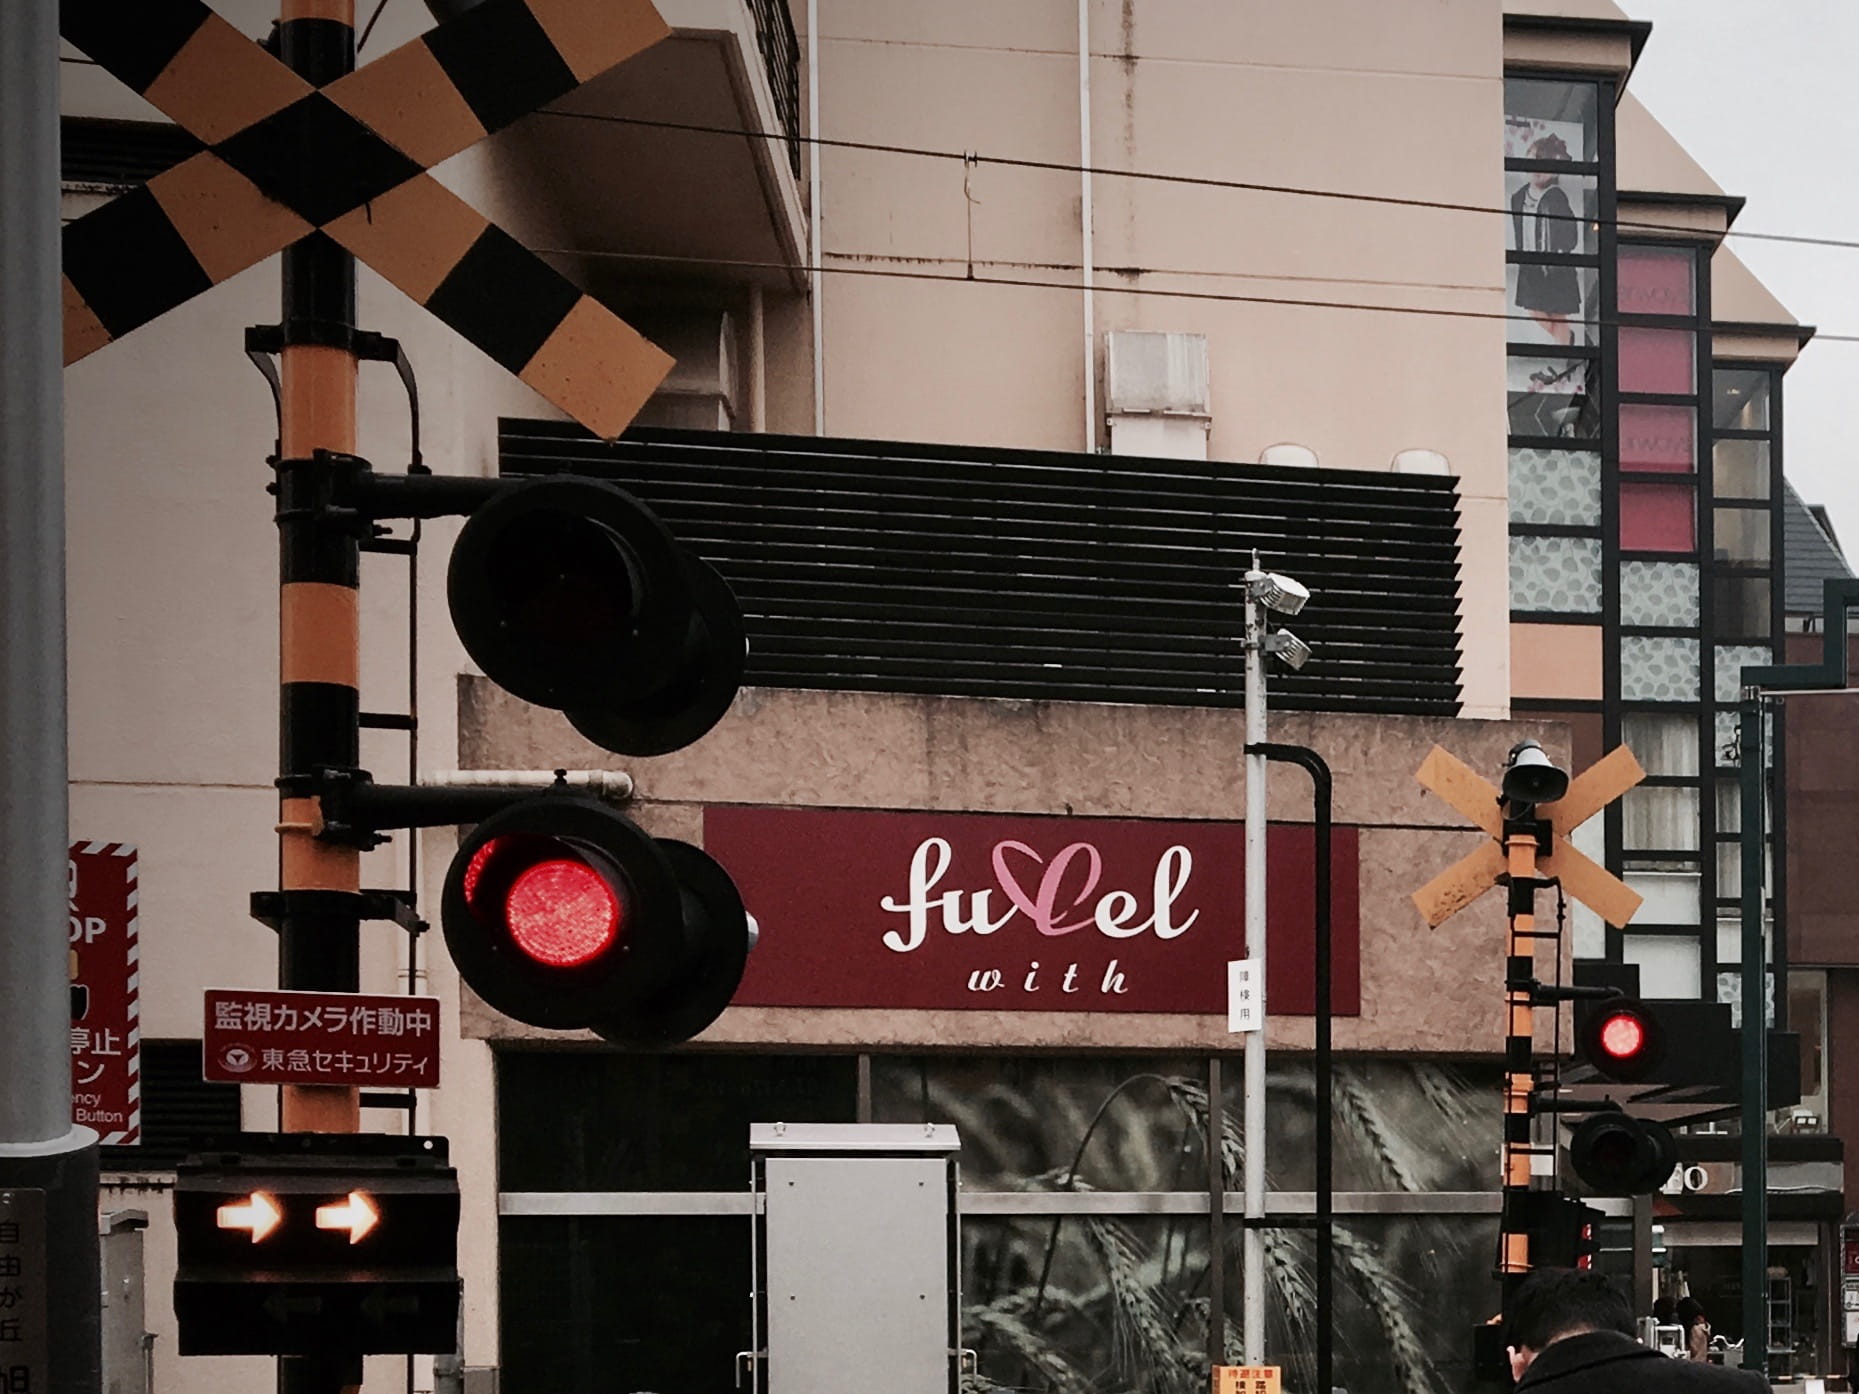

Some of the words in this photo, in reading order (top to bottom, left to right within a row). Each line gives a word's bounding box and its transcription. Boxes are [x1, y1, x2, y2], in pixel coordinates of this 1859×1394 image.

[214, 1001, 432, 1037] 監視カメラ作動中
[71, 1027, 122, 1056] 停止
[261, 1048, 428, 1075] 東急セキュリティ
[76, 1107, 123, 1123] Button
